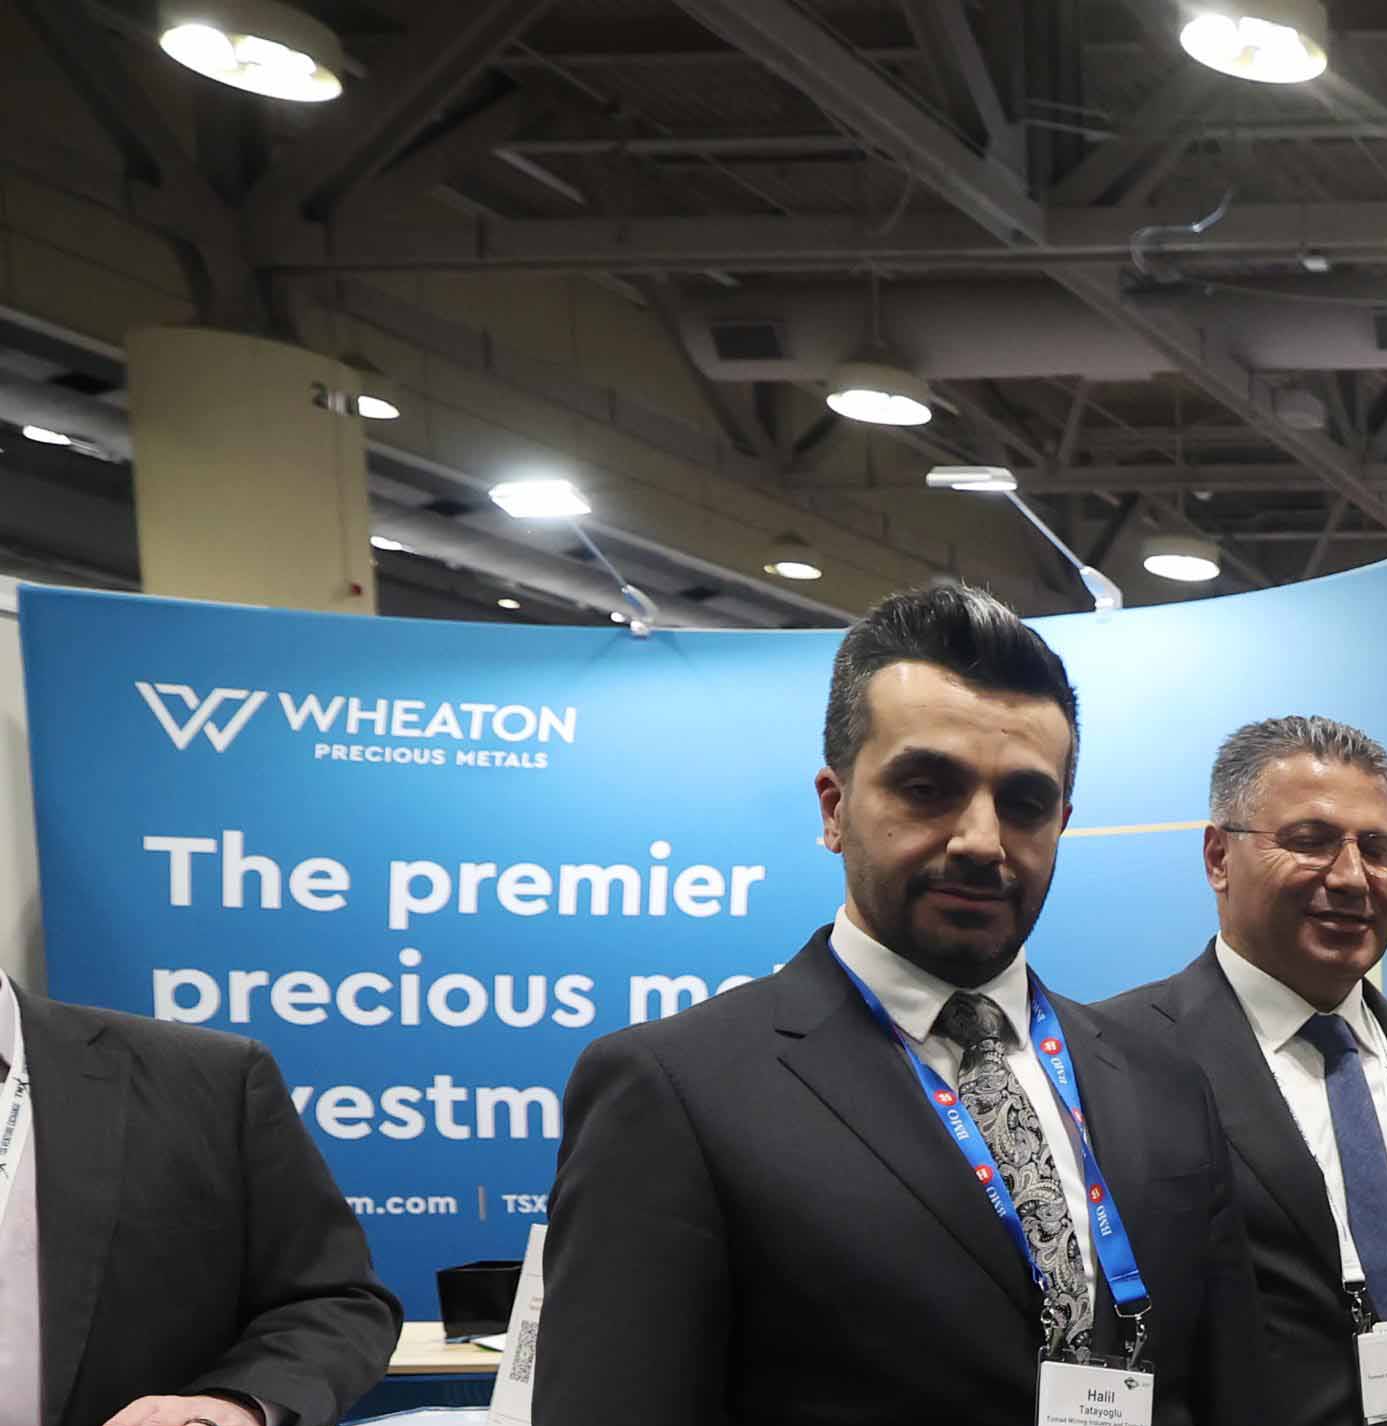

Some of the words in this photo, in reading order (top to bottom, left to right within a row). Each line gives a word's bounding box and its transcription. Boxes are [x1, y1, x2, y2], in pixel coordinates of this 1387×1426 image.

[277, 691, 577, 744] WHEATON
[314, 743, 446, 766] PRECIOUS
[456, 751, 549, 770] METALS
[143, 830, 352, 912] The
[388, 841, 766, 931] premier
[152, 946, 597, 1029] precious
[947, 1108, 970, 1143] BMO
[985, 1185, 1007, 1219] BMO
[1095, 1205, 1113, 1238] BMO
[1079, 1405, 1123, 1420] Tatayoglu
[1087, 1389, 1116, 1404] Halil
